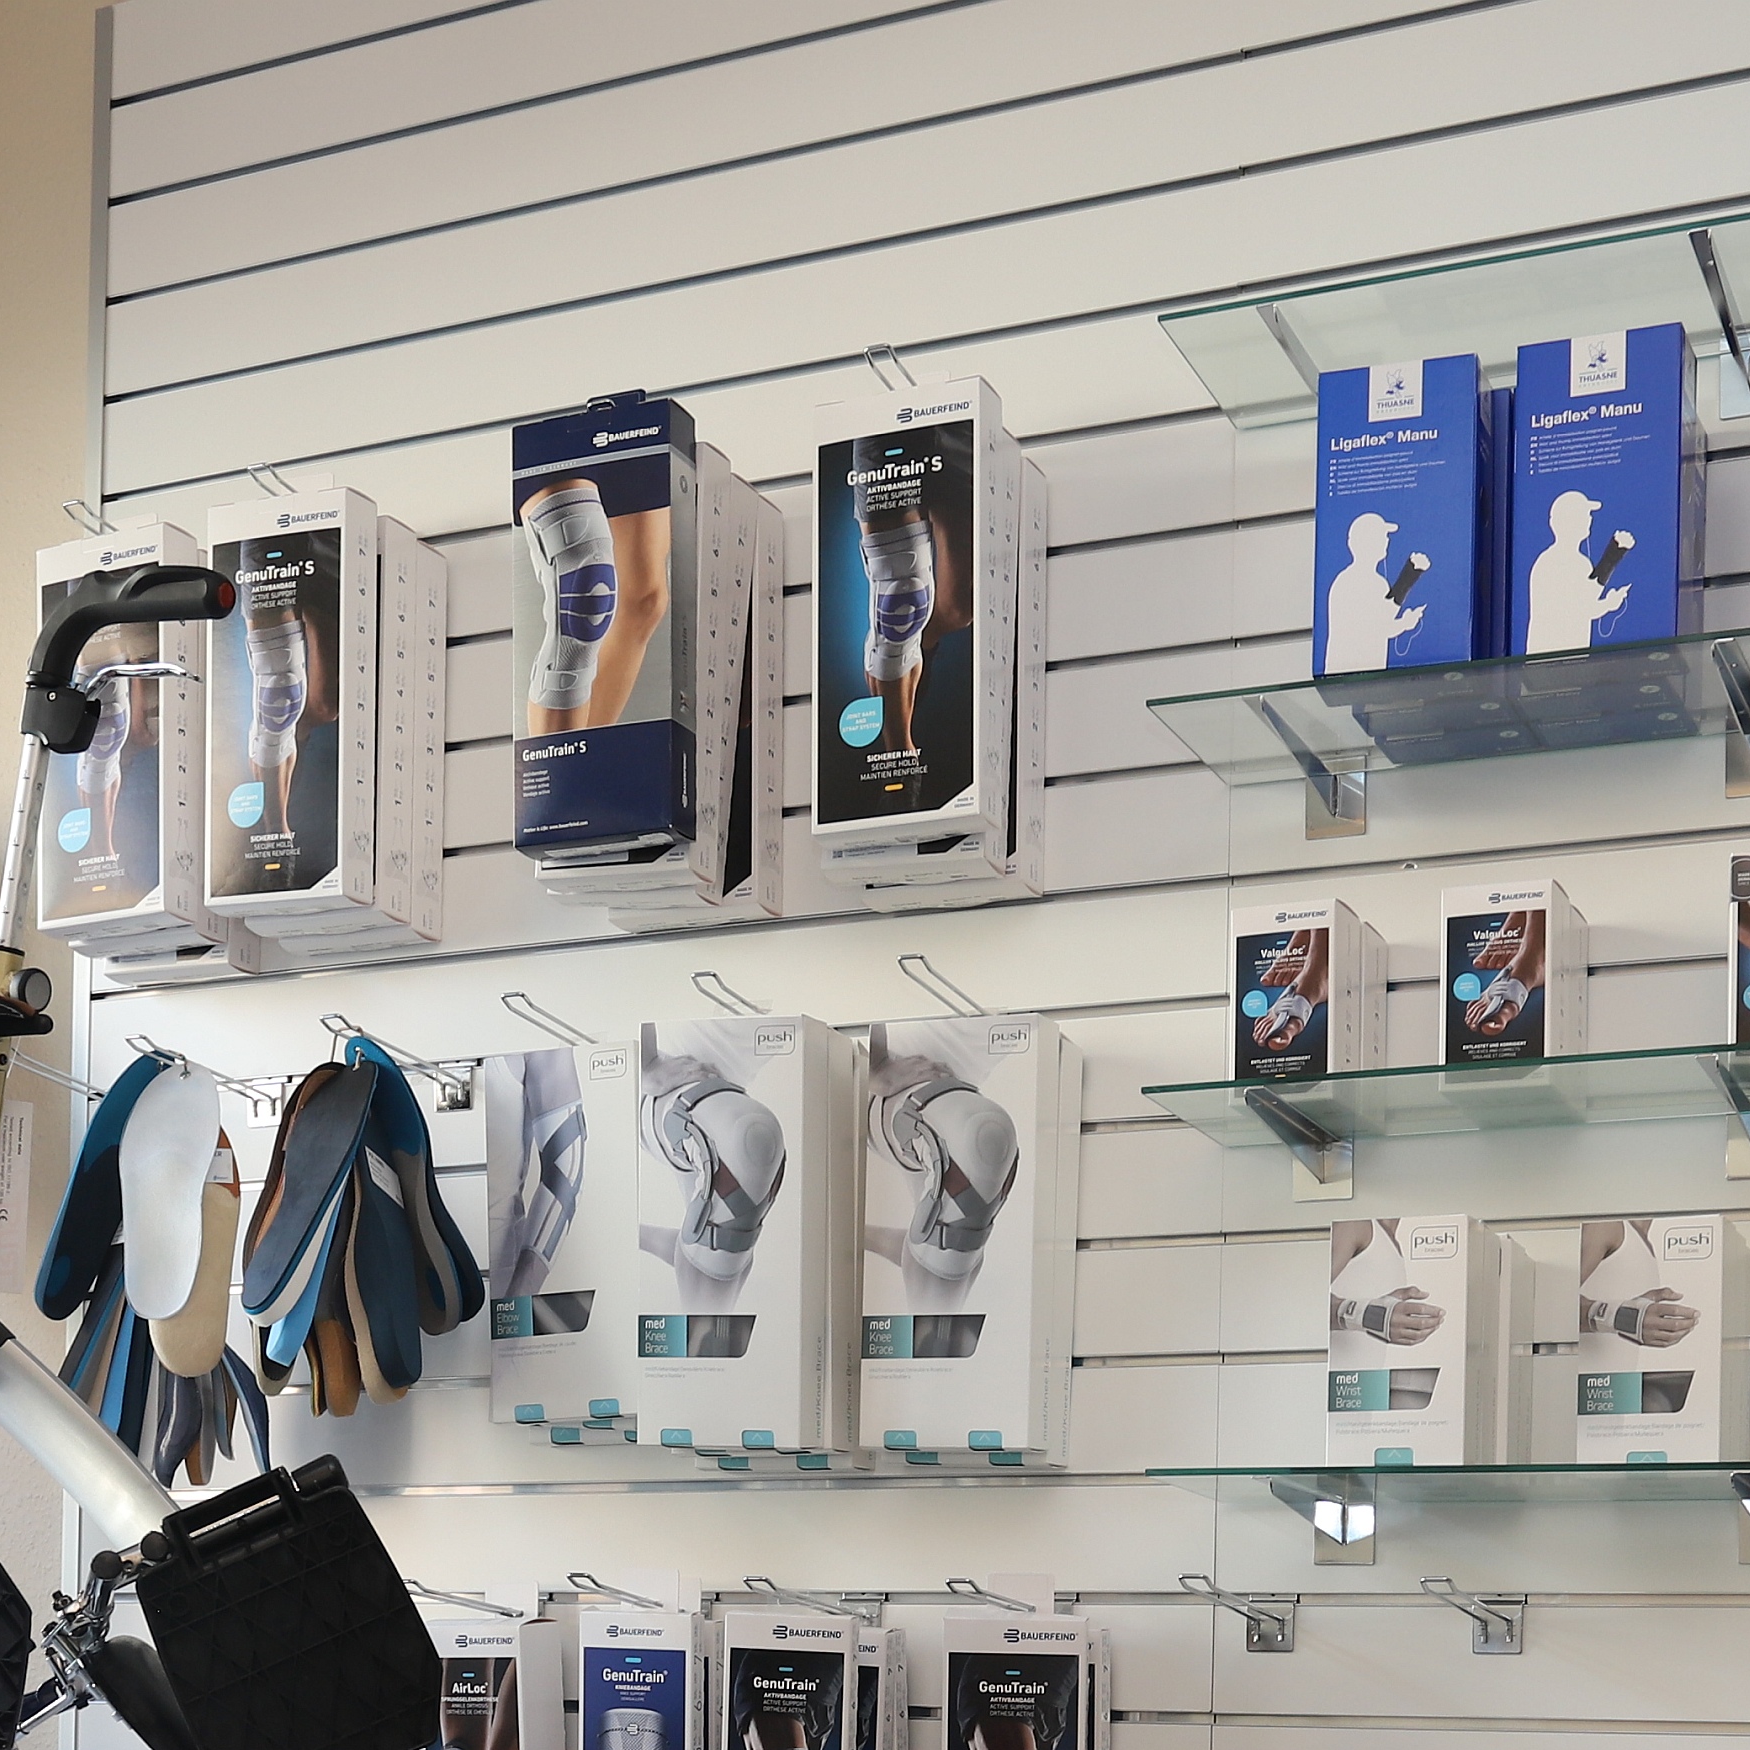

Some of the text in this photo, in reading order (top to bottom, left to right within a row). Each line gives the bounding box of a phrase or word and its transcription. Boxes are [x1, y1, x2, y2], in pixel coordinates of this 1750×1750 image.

[1578, 370, 1618, 384] THUASNE
[914, 401, 970, 418] BAUERFEIND
[1376, 398, 1415, 409] THUASNE
[1600, 402, 1644, 418] Manu
[609, 426, 661, 443] BAUERFEIND
[1397, 428, 1438, 443] Manu
[847, 455, 943, 486] GenuTrain S
[867, 479, 922, 495] AKTIVBANDAGE
[291, 510, 339, 523] BAUERFEIND
[113, 544, 158, 561] BAUERFEIND
[235, 560, 315, 584] GenuTrain S
[522, 741, 587, 762] GenuTrain S
[867, 748, 922, 763] SICHERER HALT
[871, 761, 897, 772] SECURE
[860, 769, 892, 781] MAINTIEN
[757, 1029, 794, 1047] push
[991, 1028, 1029, 1045] push
[591, 1054, 625, 1072] push
[1414, 1232, 1455, 1249] push
[1667, 1233, 1710, 1250] push
[496, 1301, 515, 1312] med
[497, 1312, 520, 1324] Elbow
[645, 1318, 665, 1330] med
[869, 1317, 891, 1331] med
[497, 1324, 519, 1335] Brace
[645, 1331, 667, 1342] Knee
[869, 1331, 892, 1343] Knee
[645, 1342, 669, 1354] Brace
[869, 1343, 894, 1355] Brace
[1336, 1372, 1358, 1385] med
[1587, 1376, 1610, 1388] med
[1336, 1385, 1362, 1397] Wrist
[1587, 1387, 1614, 1399] Wrist
[1336, 1397, 1362, 1409] Brace
[1587, 1399, 1614, 1411] Brace
[619, 1628, 664, 1637] BAUERFEIND
[789, 1629, 842, 1639] BAUERFEIND
[1020, 1632, 1076, 1641] BAUERFEIND
[468, 1637, 514, 1646] BAUERFEIND
[602, 1668, 665, 1683] GenuTrain
[452, 1682, 487, 1695] AirLoc
[753, 1676, 817, 1691] GenuTrain
[979, 1680, 1045, 1695] GenuTrain
